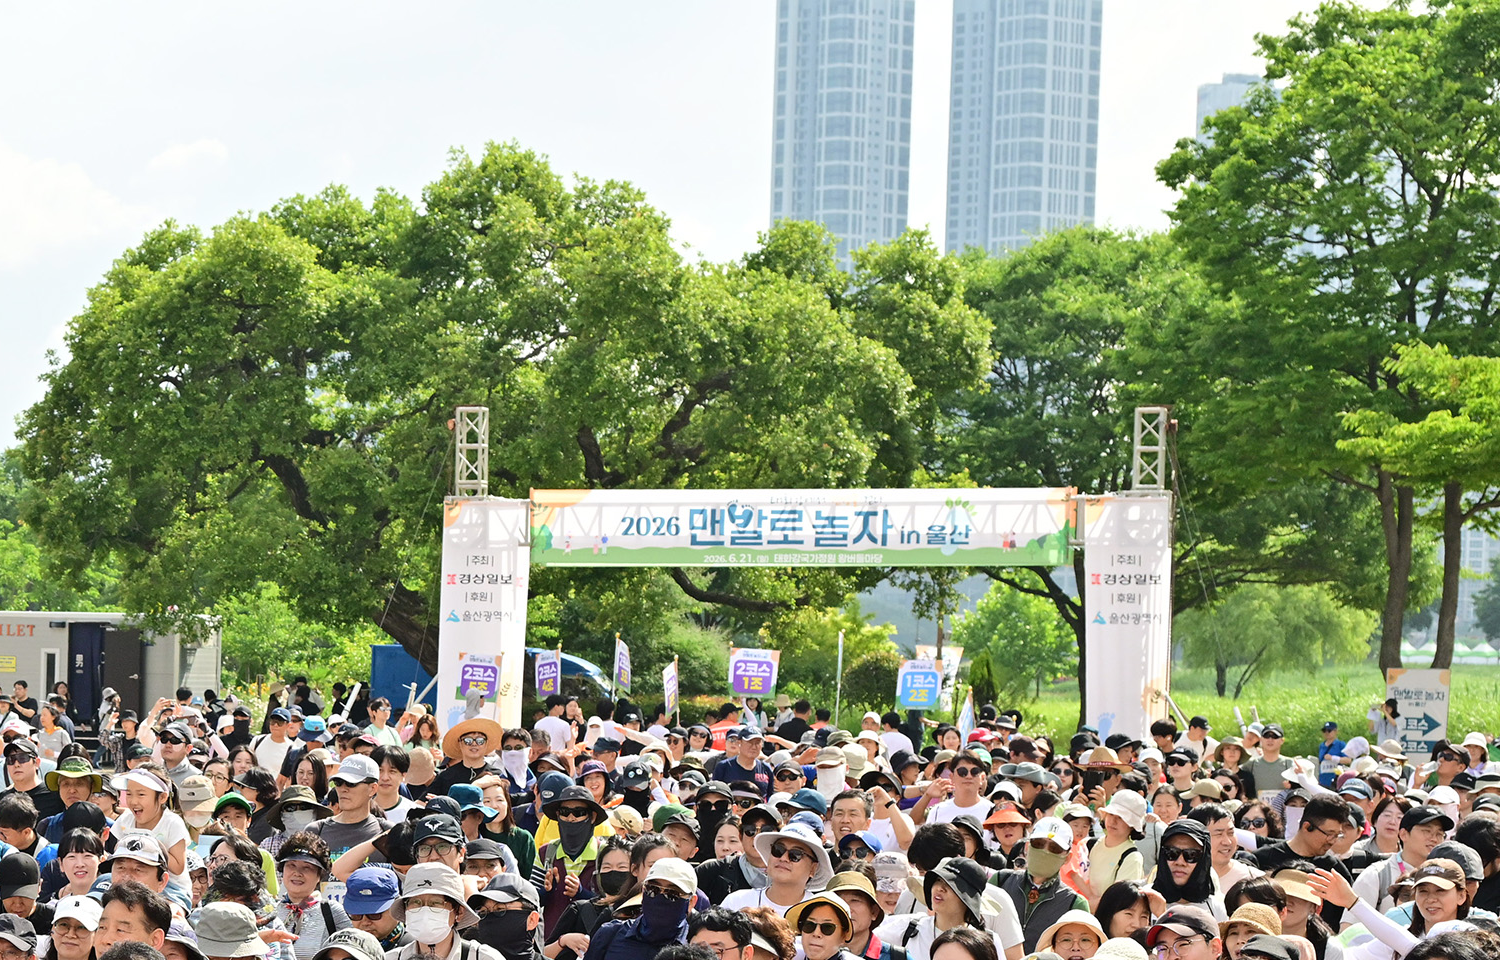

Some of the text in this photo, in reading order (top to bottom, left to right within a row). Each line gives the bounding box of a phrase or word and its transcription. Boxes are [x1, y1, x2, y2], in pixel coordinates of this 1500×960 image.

[621, 516, 680, 536] 2026
[688, 501, 804, 546] 맨발로
[812, 509, 894, 548] 놀자
[900, 525, 920, 544] in
[926, 524, 972, 545] 울산
[472, 555, 489, 565] 주최
[774, 553, 836, 564] 태화강국가정원
[1117, 554, 1136, 565] 주최
[459, 574, 512, 585] 경상일보
[1104, 573, 1161, 585] 경상일보
[470, 592, 488, 602] 후원
[1117, 592, 1136, 604] 후원
[463, 610, 512, 622] 울산광역시
[1109, 612, 1162, 625] 울산광역시
[76, 654, 84, 668] 男
[464, 667, 495, 682] 2코스
[539, 664, 556, 680] 2코스
[736, 662, 770, 676] 2코스
[542, 678, 554, 692] 4조
[742, 677, 763, 690] 1조
[906, 674, 936, 688] 1코스
[908, 689, 928, 702] 2조
[1425, 690, 1445, 701] 놀자
[1407, 718, 1428, 730] 코스
